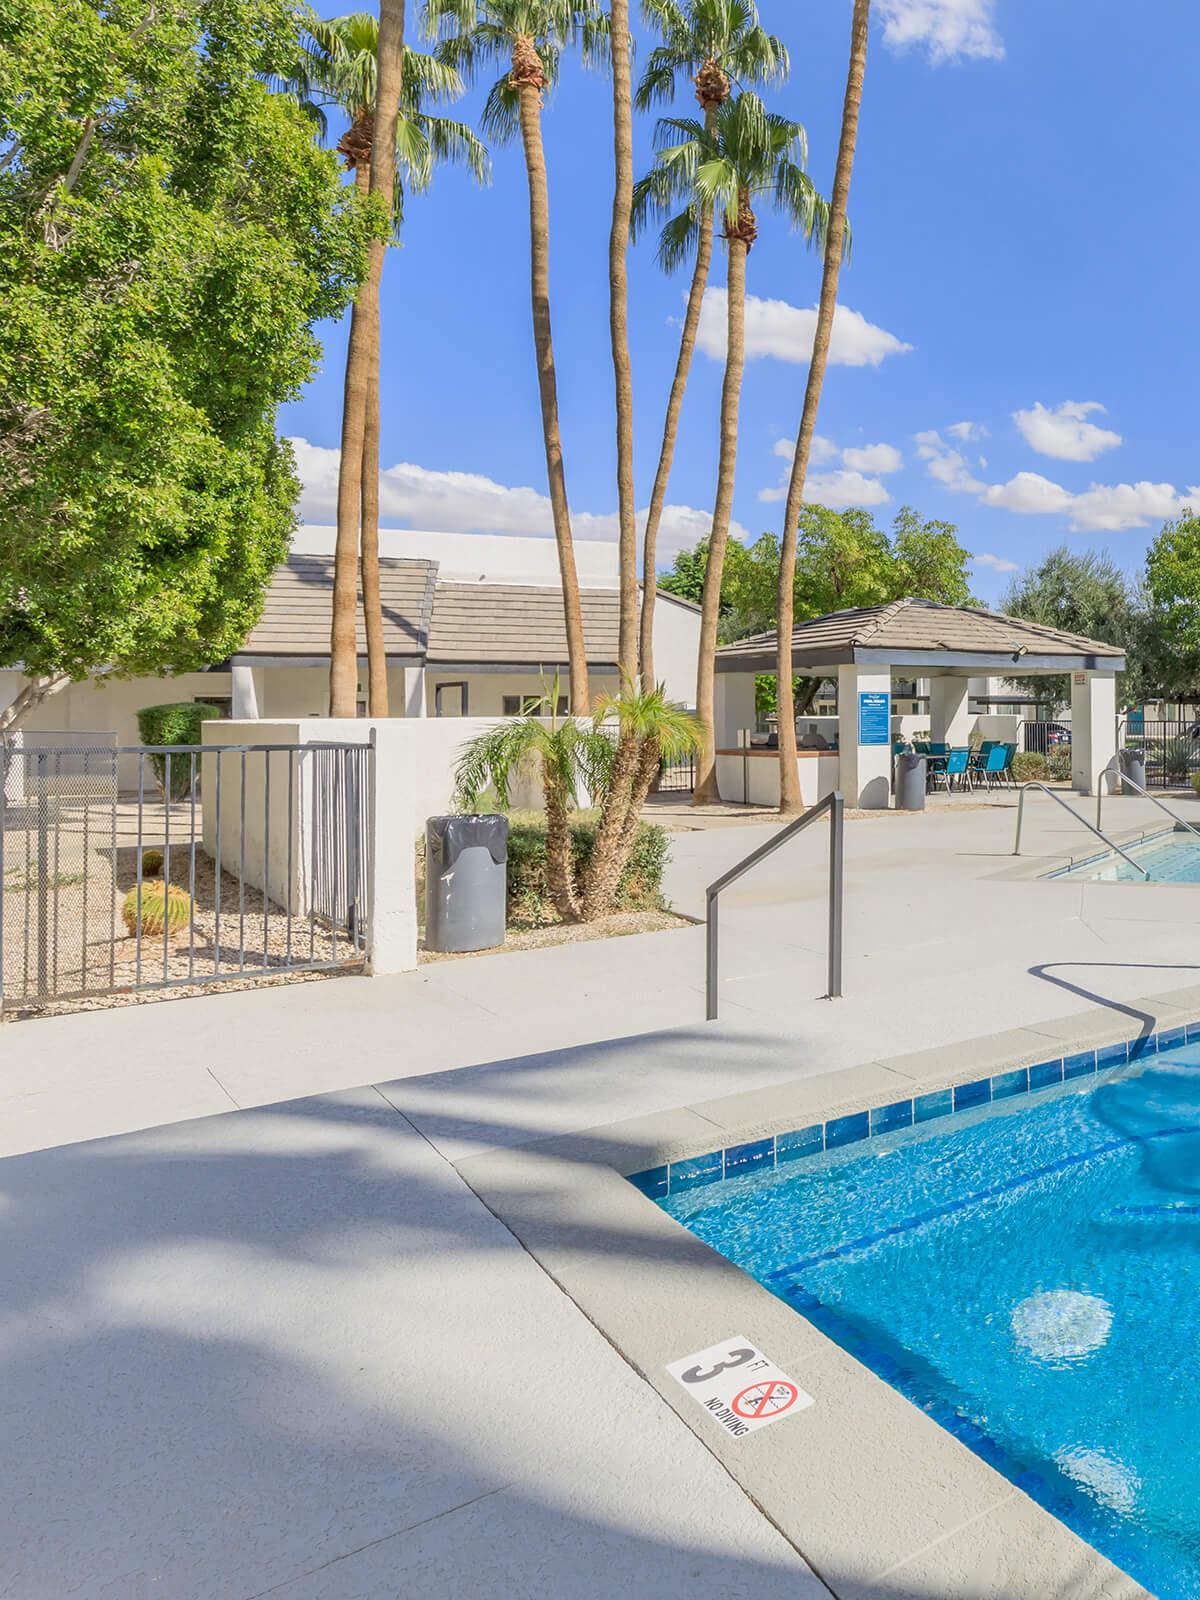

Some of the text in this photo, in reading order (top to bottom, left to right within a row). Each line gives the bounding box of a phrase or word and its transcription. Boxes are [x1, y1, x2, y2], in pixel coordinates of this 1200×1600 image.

[681, 1348, 770, 1383] 3 FT
[703, 1396, 750, 1437] NO DIVING
